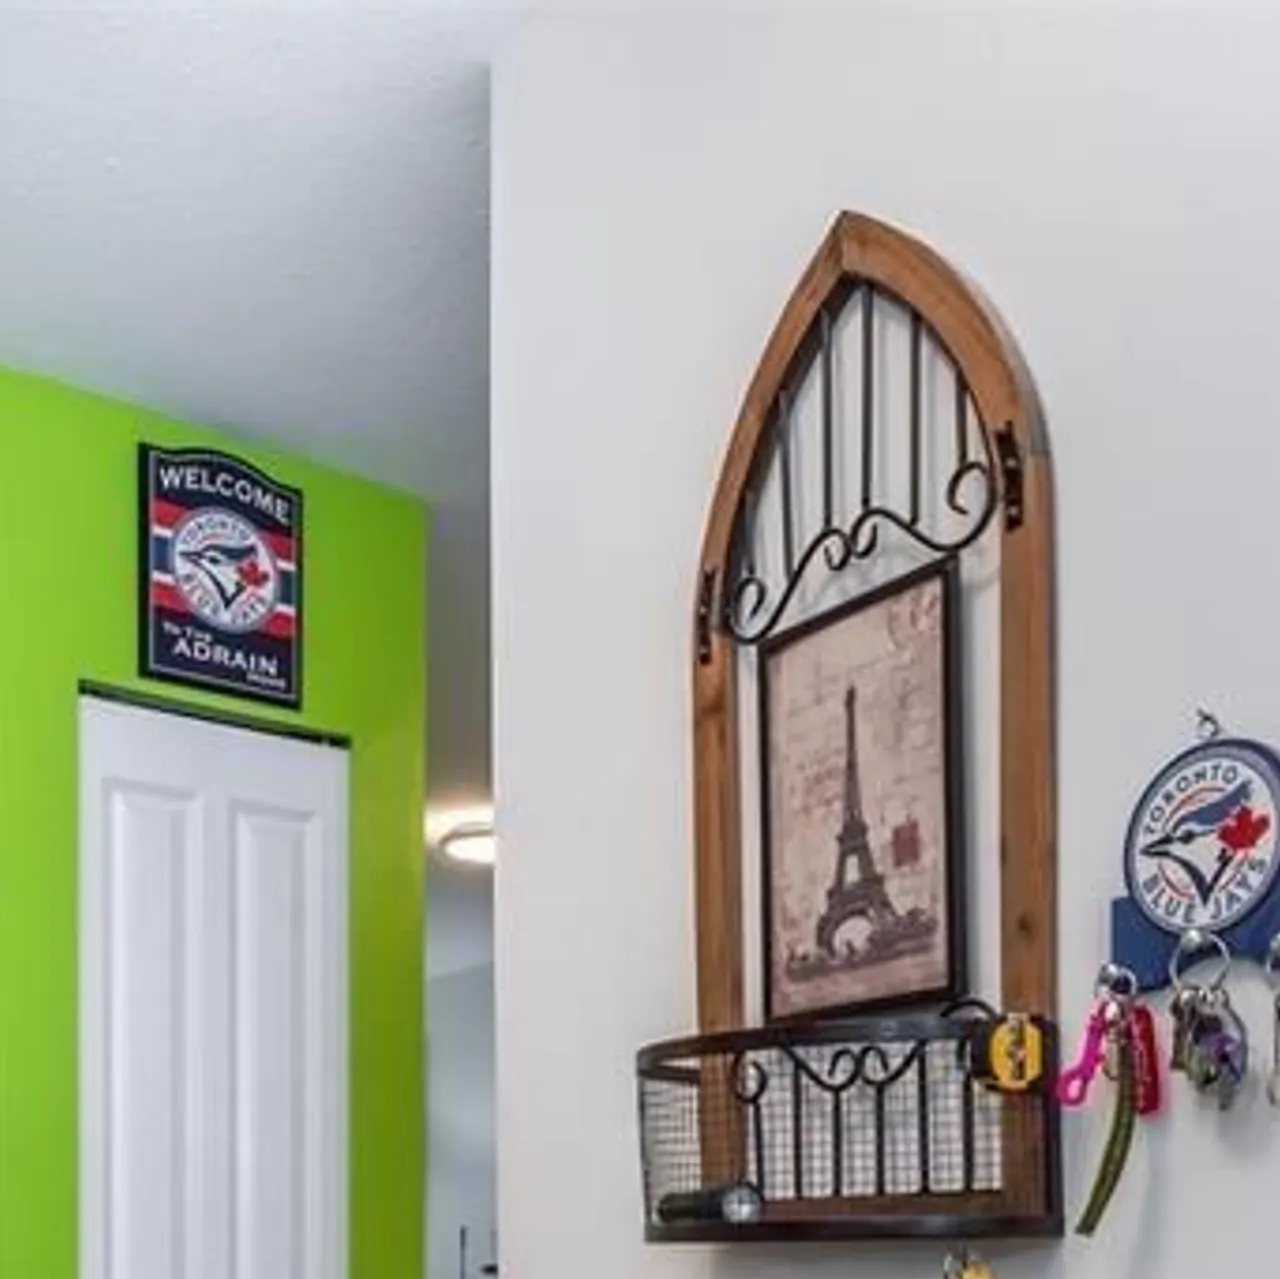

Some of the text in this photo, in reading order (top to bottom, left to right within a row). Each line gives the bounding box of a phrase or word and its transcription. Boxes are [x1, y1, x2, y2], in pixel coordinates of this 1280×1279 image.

[160, 465, 291, 527] WELCOME
[173, 638, 278, 677] ADRAIN
[1144, 764, 1238, 835] TORONTO
[1142, 872, 1197, 924] BLUE
